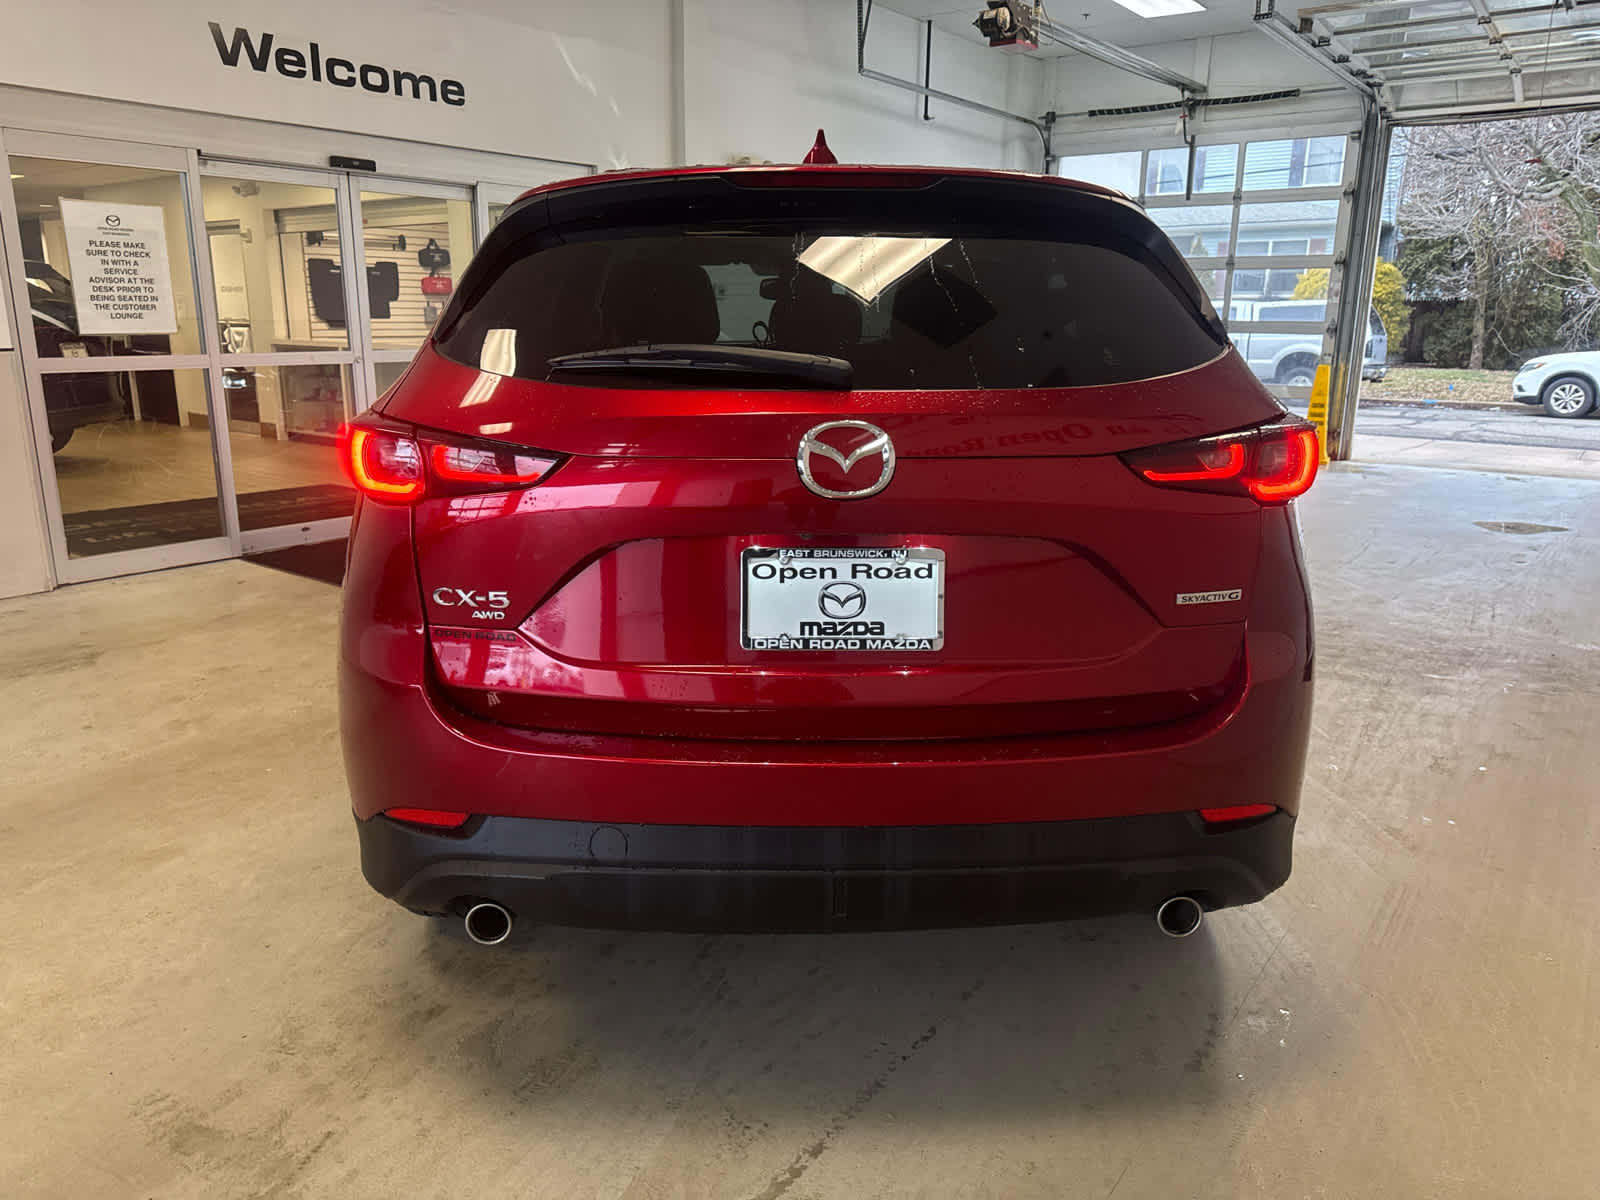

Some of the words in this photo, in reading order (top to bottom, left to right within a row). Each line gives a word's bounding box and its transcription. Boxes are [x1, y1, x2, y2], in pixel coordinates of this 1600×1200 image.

[208, 21, 465, 106] Welcome
[88, 240, 121, 249] PLEASE
[123, 241, 146, 250] MAKE
[86, 249, 108, 257] SURE
[111, 250, 121, 258] TO
[123, 250, 151, 259] CHECK
[100, 258, 109, 266] IN
[111, 259, 131, 267] WITH
[103, 267, 139, 276] SERVICE
[89, 276, 126, 284] ADVISOR
[127, 277, 138, 285] AT
[140, 277, 155, 285] THE
[92, 285, 115, 293] DESK
[117, 286, 142, 294] PRIOR
[143, 286, 154, 294] TO
[90, 294, 116, 302] BEING
[117, 294, 149, 302] SEATED
[94, 303, 111, 311] THE
[112, 303, 157, 311] CUSTOMER
[110, 312, 144, 320] LOUNGE
[779, 549, 813, 559] EAST
[891, 549, 908, 559] NJ
[752, 563, 837, 583] Open
[851, 563, 933, 579] Road
[432, 587, 510, 609] CX-5
[472, 611, 505, 620] AWD
[434, 629, 472, 639] OPEN
[475, 631, 517, 641] ROAD
[754, 639, 803, 650] OPEN
[809, 639, 861, 650] ROAD
[866, 639, 932, 650] MAZDA
